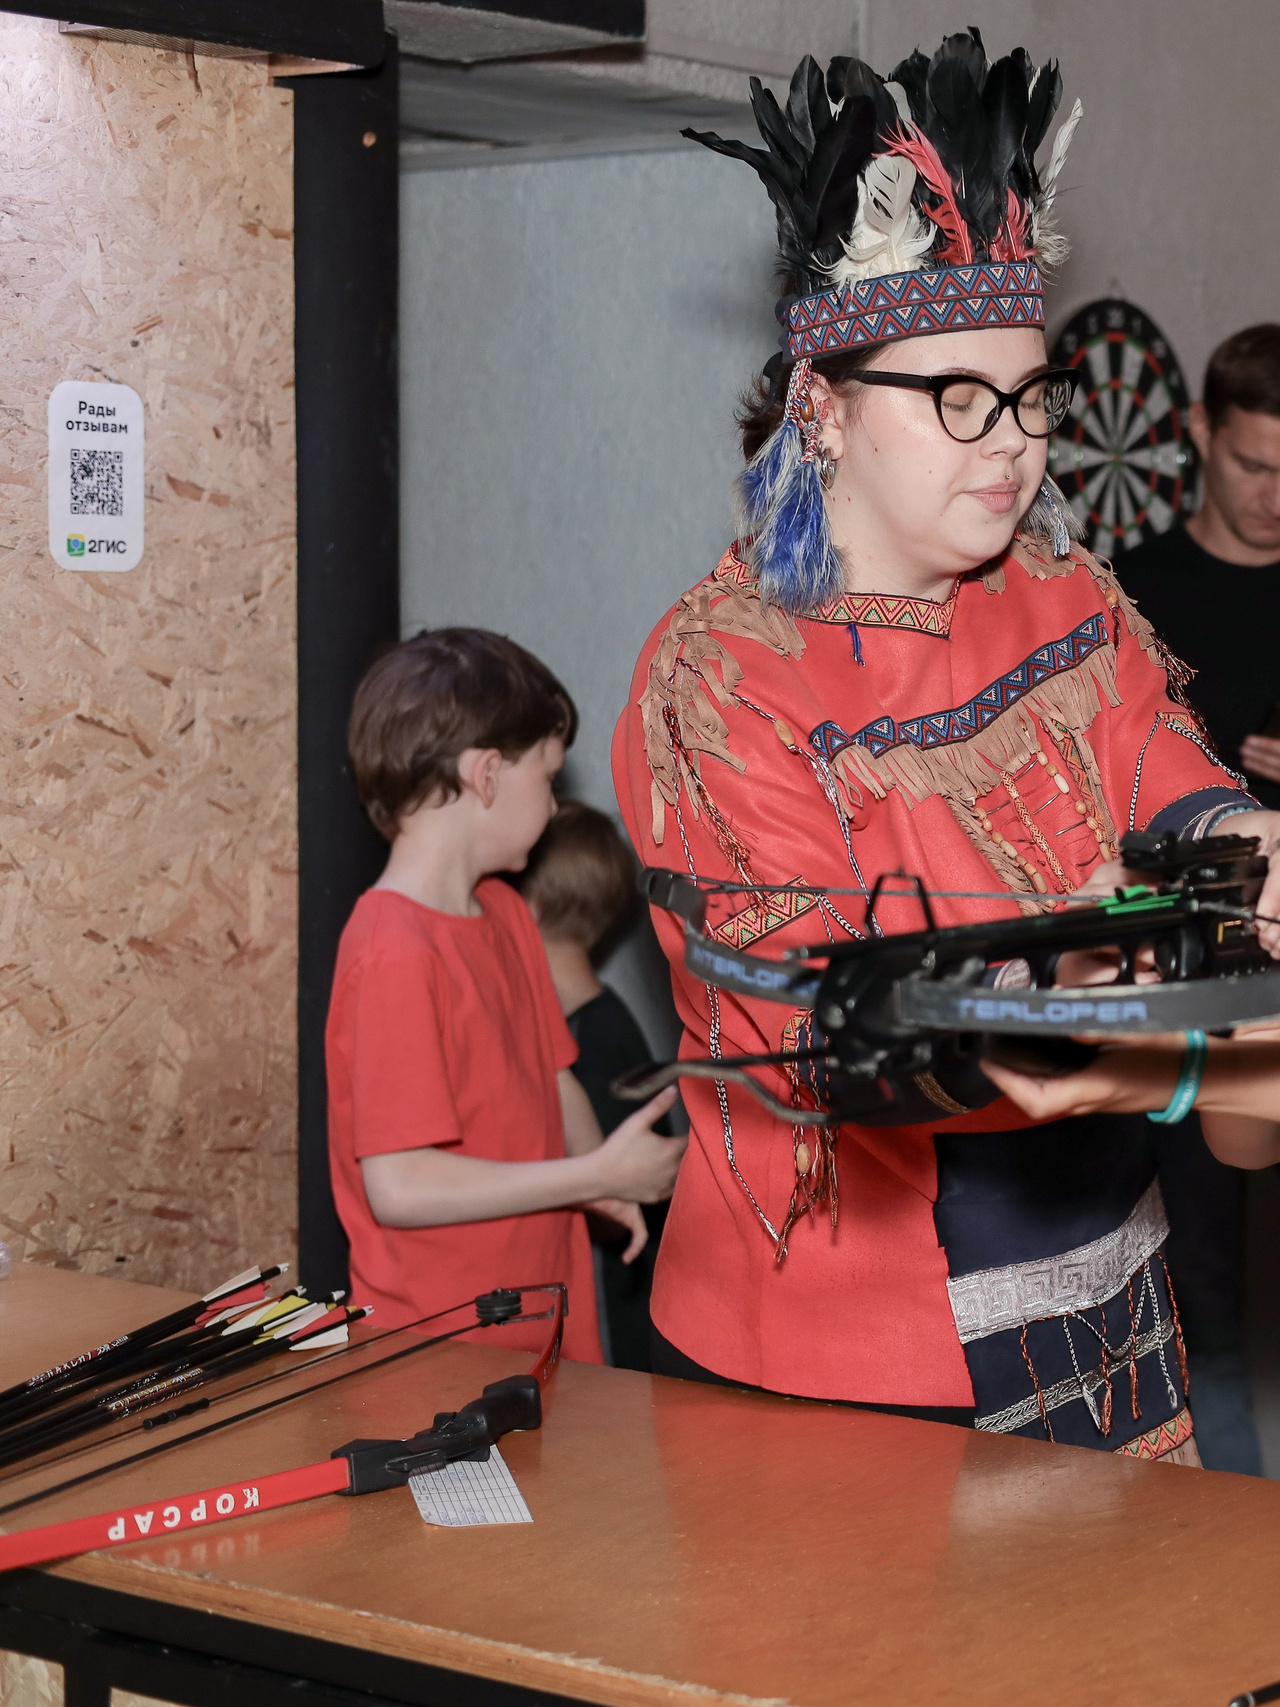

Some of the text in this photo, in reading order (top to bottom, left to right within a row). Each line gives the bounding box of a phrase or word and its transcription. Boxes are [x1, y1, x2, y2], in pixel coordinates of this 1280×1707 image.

[78, 400, 116, 417] Рады
[65, 419, 128, 434] отзывам
[88, 539, 127, 554] 2ГИС
[692, 945, 822, 997] NTERLOP
[957, 998, 1148, 1024] TERLOPER
[107, 1487, 260, 1541] КОРСАР
